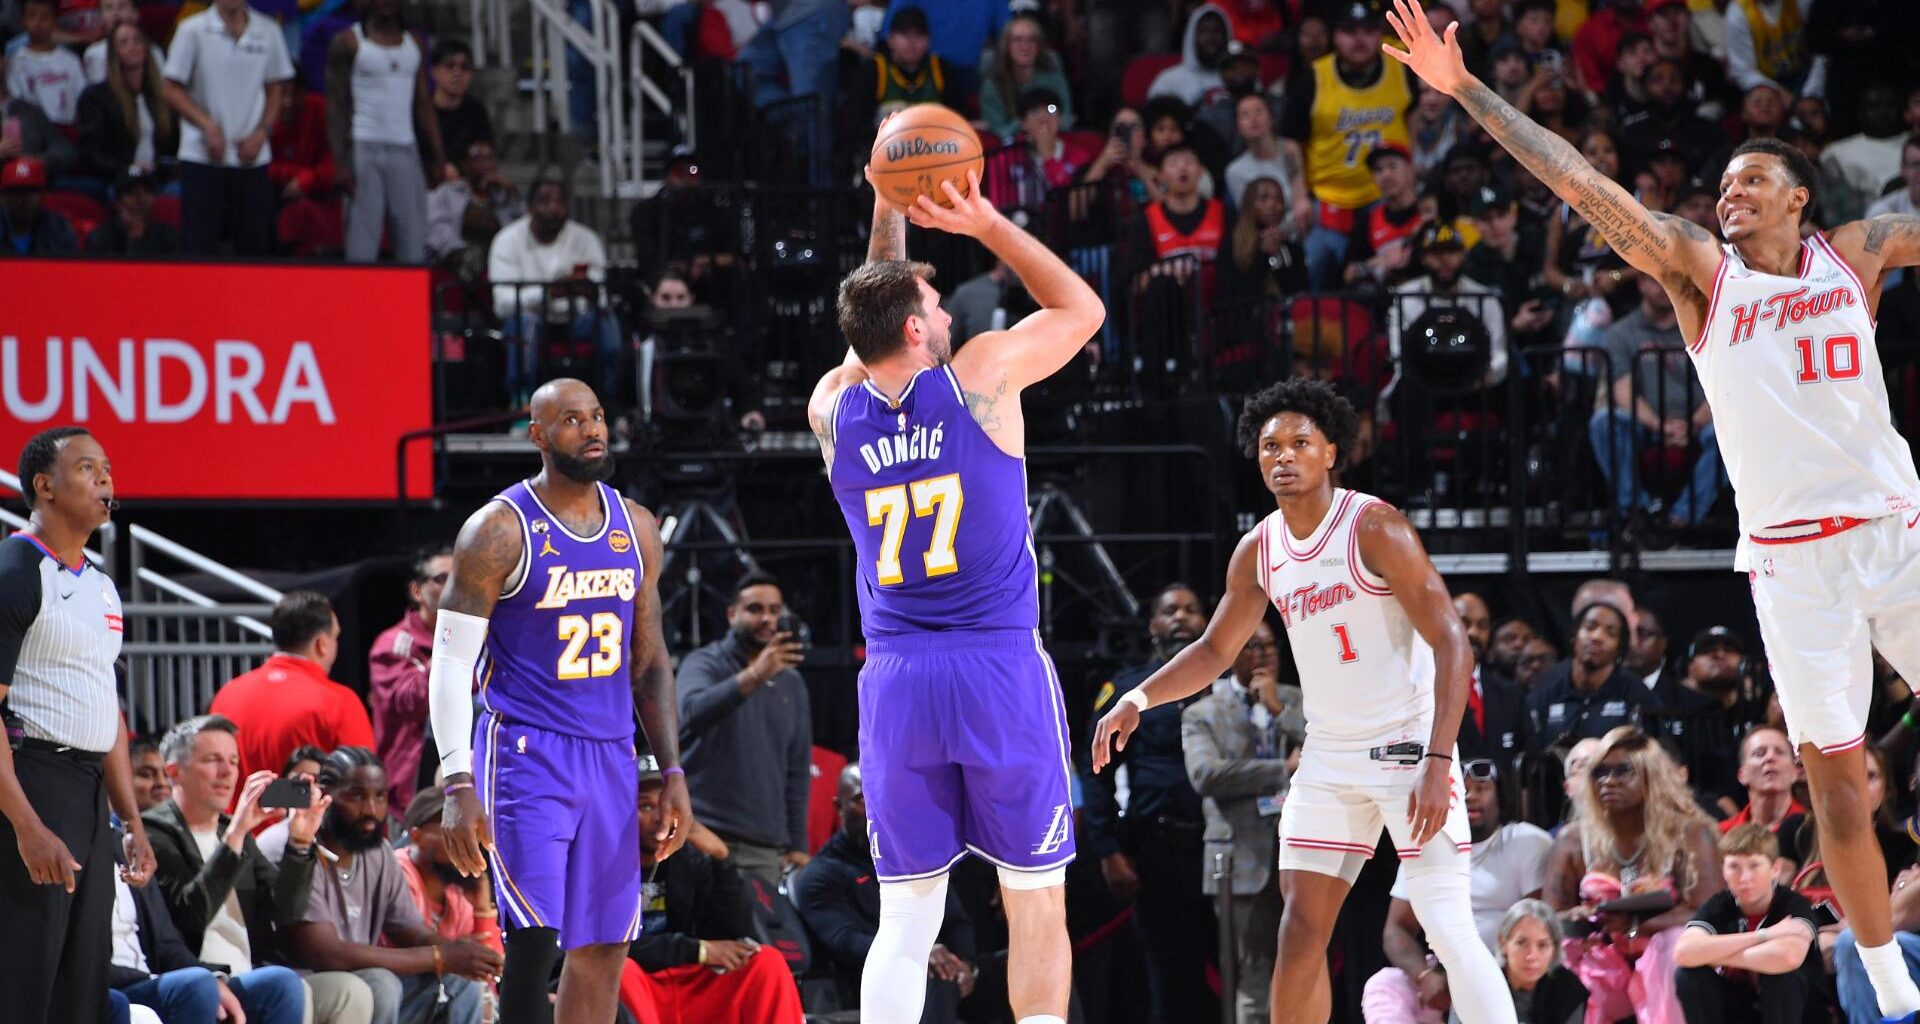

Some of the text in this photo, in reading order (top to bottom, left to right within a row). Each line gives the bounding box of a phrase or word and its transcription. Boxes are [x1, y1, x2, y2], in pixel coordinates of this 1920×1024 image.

[886, 136, 959, 163] Wilson
[1344, 130, 1383, 168] 77
[1568, 177, 1625, 230] MEDIOCRITY
[1622, 228, 1641, 247] And
[1578, 199, 1632, 255] POTENTIAL
[1587, 178, 1668, 250] Complacency Breeds
[1729, 286, 1857, 347] H-Town
[2, 336, 336, 425] UNDRA
[1794, 332, 1863, 385] 10
[859, 421, 944, 475] DONČIĆ
[864, 472, 964, 586] 77
[535, 565, 636, 610] LAKERS
[1276, 582, 1356, 629] H-Town
[557, 612, 623, 681] 23
[1330, 622, 1359, 665] 1
